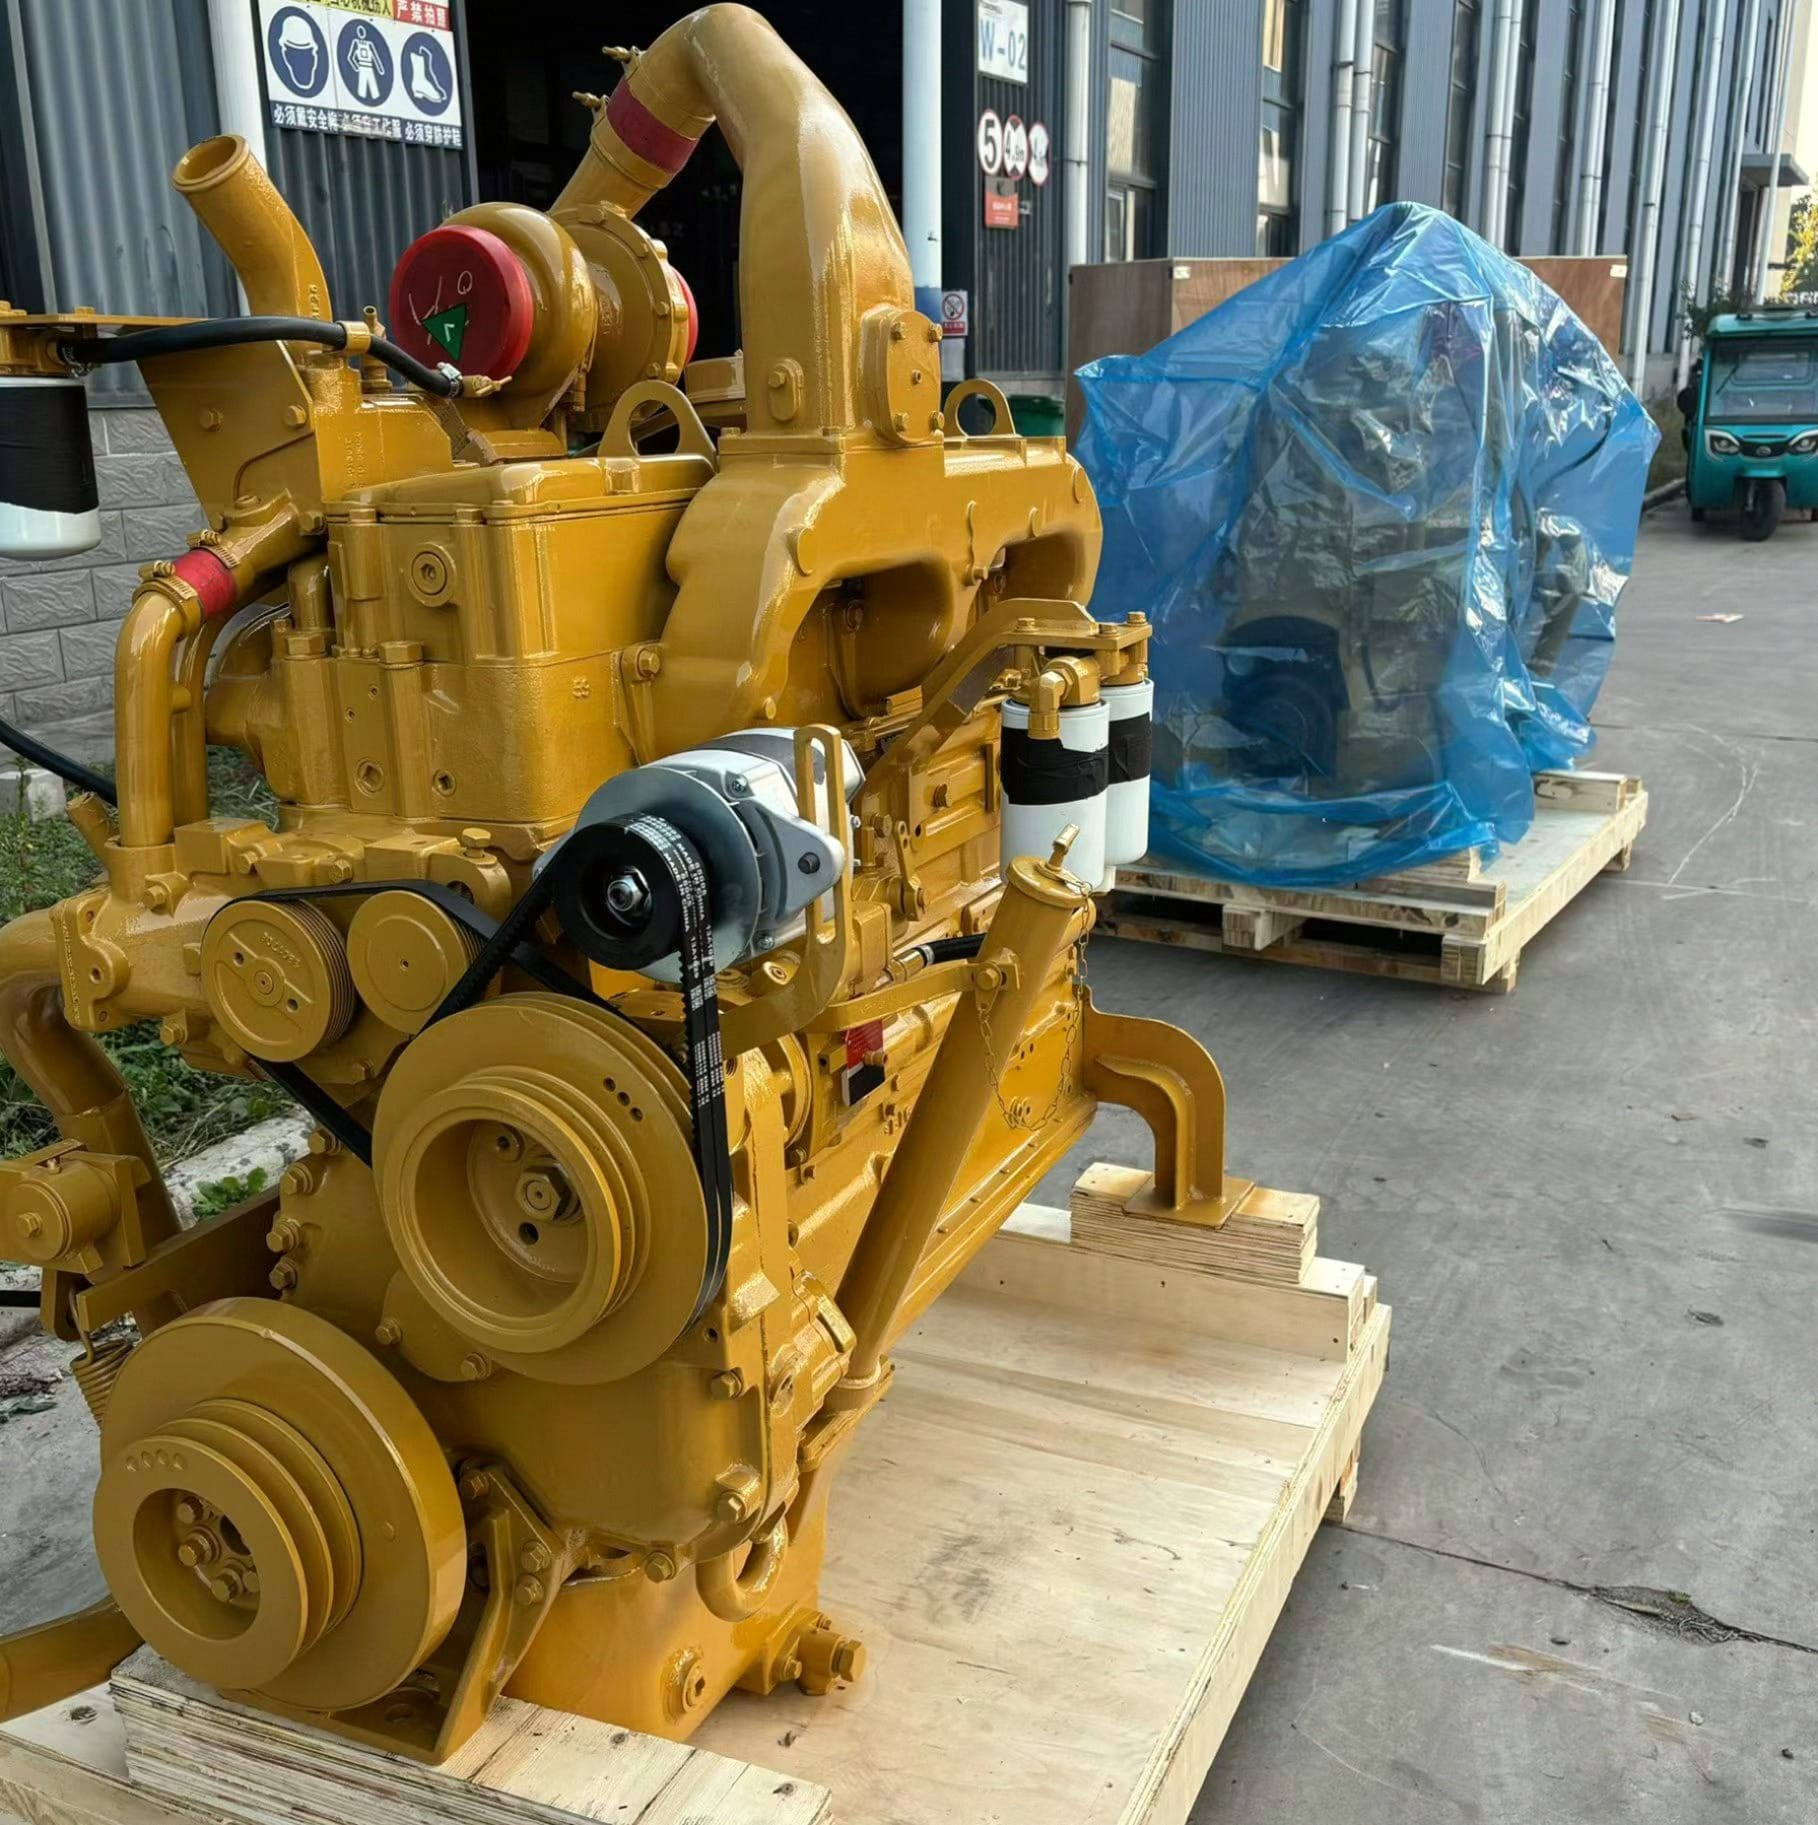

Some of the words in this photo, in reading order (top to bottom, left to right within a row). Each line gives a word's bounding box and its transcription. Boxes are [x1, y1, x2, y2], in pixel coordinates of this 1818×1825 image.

[980, 17, 1026, 70] W-02
[984, 119, 997, 169] 5
[676, 843, 696, 871] MADE
[663, 852, 681, 882] MADE
[681, 898, 691, 933] CHINA
